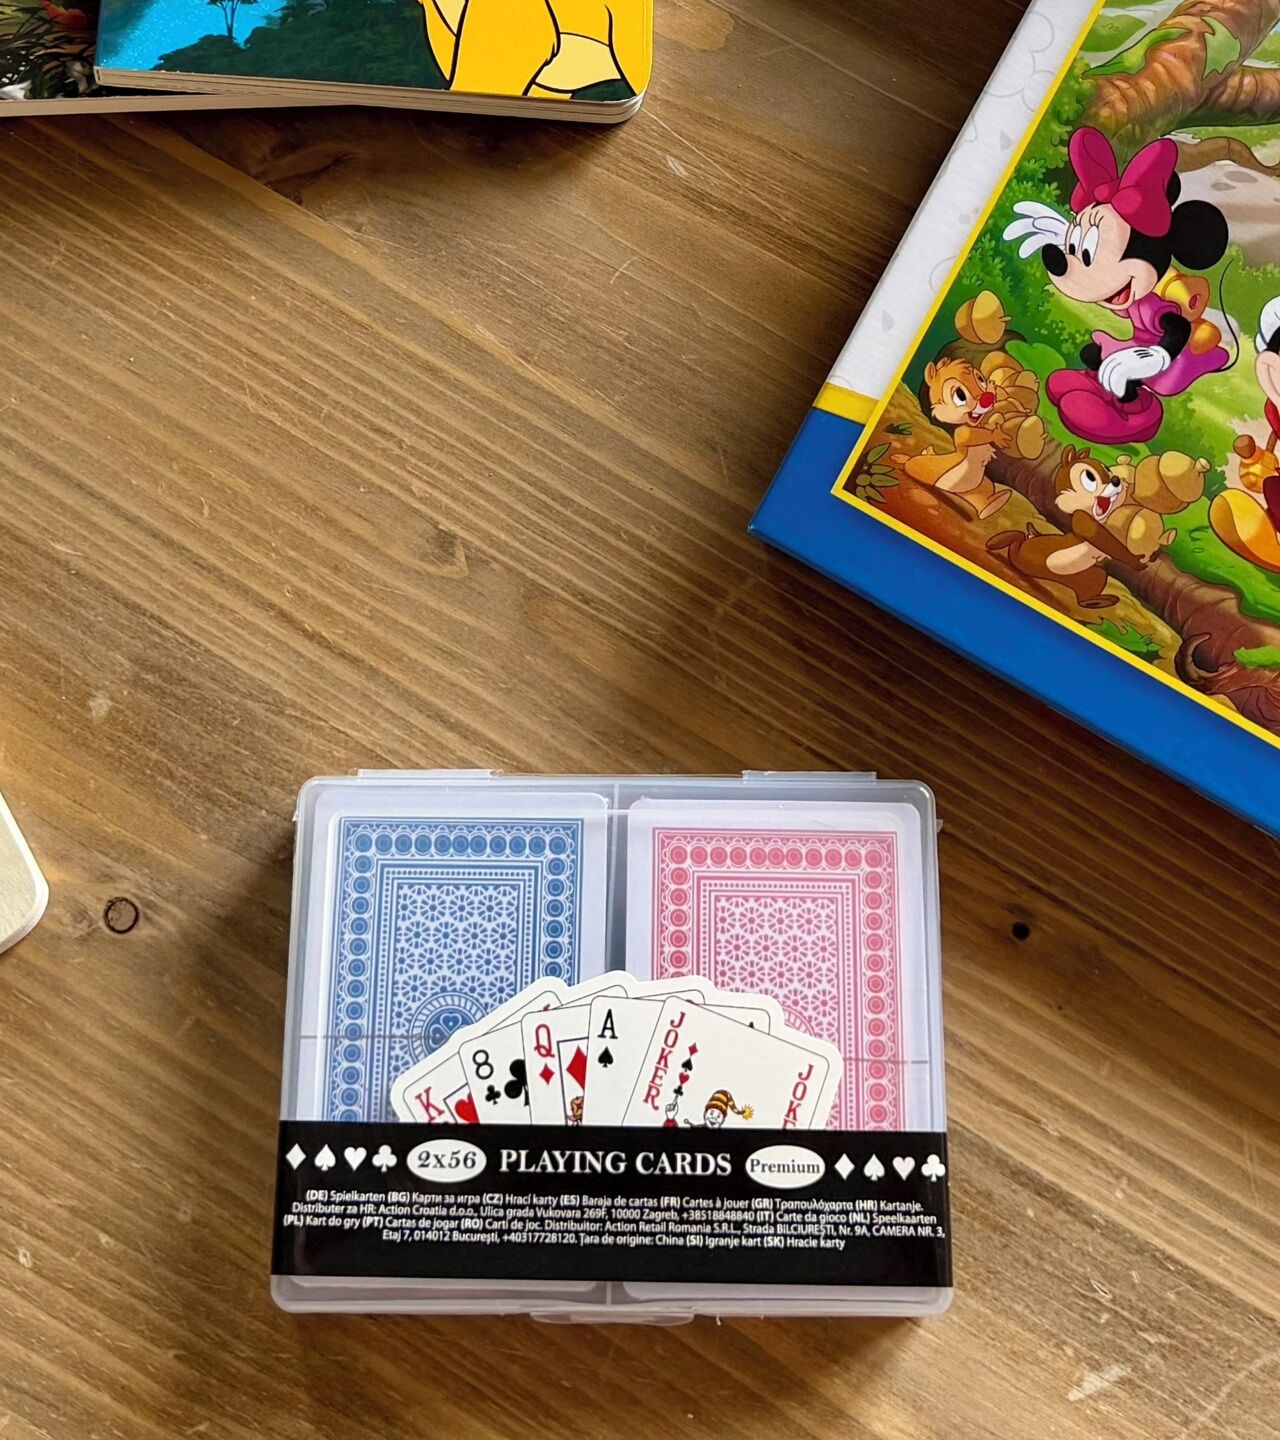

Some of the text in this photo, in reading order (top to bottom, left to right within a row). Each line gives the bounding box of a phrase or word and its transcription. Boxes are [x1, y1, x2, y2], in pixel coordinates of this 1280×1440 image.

[597, 1008, 619, 1039] A
[534, 1024, 555, 1058] Q
[473, 1049, 494, 1080] 8
[642, 1011, 687, 1111] JOKER
[415, 1086, 445, 1122] K
[781, 1063, 814, 1129] JOK
[417, 1150, 477, 1170] 2x56
[499, 1149, 732, 1177] PLAYING CARDS
[749, 1158, 821, 1174] Premium
[292, 1202, 345, 1214] Distributer
[346, 1205, 358, 1214] za
[378, 1204, 410, 1215] Action
[412, 1205, 447, 1215] Croatia
[480, 1206, 504, 1216] Ulica
[506, 1207, 534, 1219] grada
[537, 1207, 581, 1218] Vukovara
[611, 1209, 641, 1219] 10000
[756, 1210, 774, 1222] (IT)
[776, 1211, 802, 1222] Carte
[805, 1211, 817, 1222] da
[820, 1212, 847, 1225] gioco
[849, 1212, 870, 1224] (NL)
[872, 1213, 937, 1225] Speelkaarten
[306, 1190, 328, 1202] (DE)
[330, 1190, 385, 1202] Spielkarten
[388, 1191, 410, 1203] (BG)
[483, 1193, 503, 1205] (CZ)
[533, 1194, 557, 1207] karty
[560, 1195, 580, 1207] (ES)
[582, 1195, 612, 1208] Baraja
[614, 1195, 626, 1207] de
[628, 1197, 658, 1207] cartas
[660, 1196, 680, 1208] (FR)
[683, 1197, 713, 1208] Cartes
[723, 1197, 749, 1210] jouer
[751, 1197, 773, 1210] (GR)
[855, 1199, 877, 1211] (HR)
[283, 1215, 304, 1226] (PL)
[306, 1215, 326, 1226] Kart
[328, 1216, 342, 1226] do
[344, 1218, 360, 1229] gry
[362, 1217, 383, 1229] (PT)
[385, 1217, 416, 1228] Cartas
[418, 1218, 431, 1228] de
[432, 1218, 459, 1231] jogar
[461, 1218, 483, 1230] (RO)
[510, 1219, 524, 1230] de
[545, 1220, 603, 1231] Distribuitor:
[605, 1221, 637, 1232] Action
[639, 1221, 666, 1232] Retail
[669, 1222, 711, 1233] Romania
[743, 1223, 774, 1234] Strada
[839, 1225, 853, 1236] Nr.
[872, 1225, 916, 1236] CAMERA
[383, 1230, 402, 1242] Etaj
[403, 1230, 413, 1242] 7,
[414, 1230, 450, 1242] 014012
[602, 1233, 614, 1244] de
[616, 1234, 654, 1247] origine:
[656, 1234, 684, 1245] China
[686, 1235, 703, 1247] (SI)
[705, 1235, 740, 1248] Igranje
[742, 1236, 761, 1247] kart
[763, 1236, 785, 1248] (SK)
[787, 1237, 818, 1247] Hracie
[820, 1236, 846, 1250] karty
